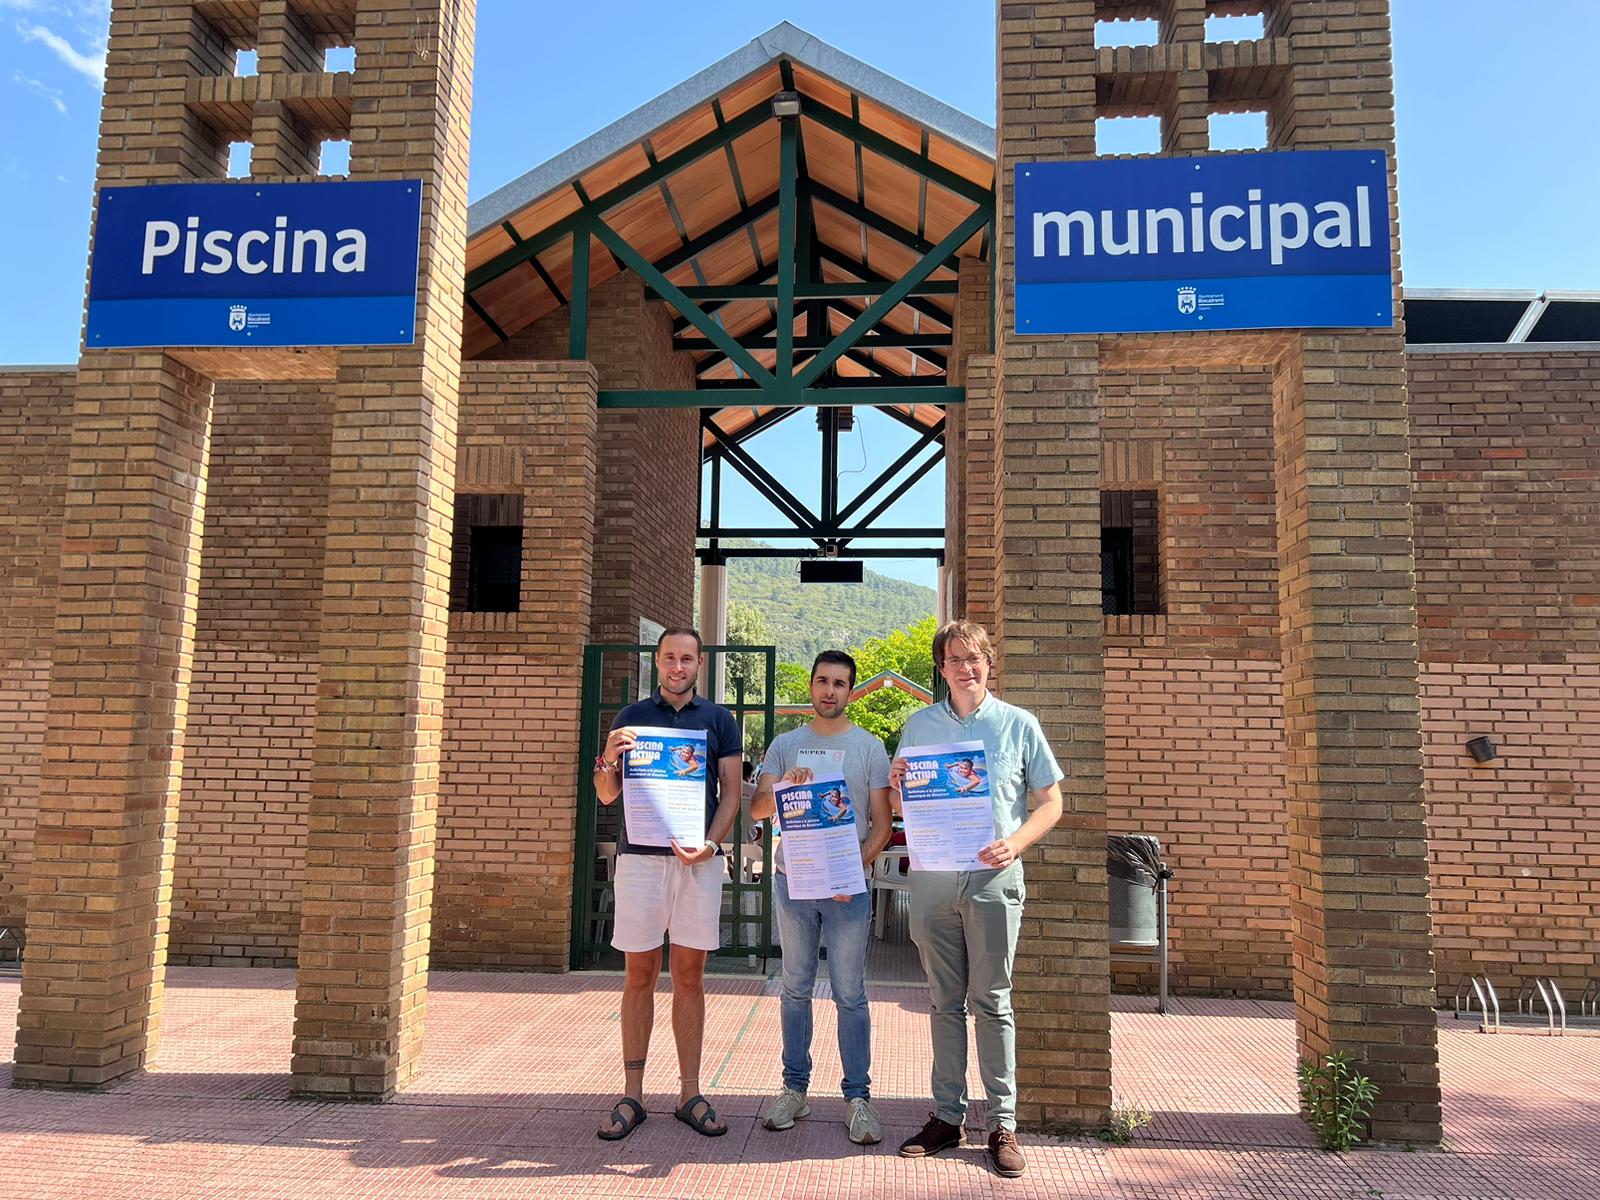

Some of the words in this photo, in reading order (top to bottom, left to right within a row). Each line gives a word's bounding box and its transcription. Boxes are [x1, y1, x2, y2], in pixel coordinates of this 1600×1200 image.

[1033, 186, 1371, 265] municipal
[141, 216, 367, 275] Piscina
[906, 770, 938, 780] ACTIVA
[781, 790, 812, 802] PISCINA
[783, 800, 812, 812] ACTIVA
